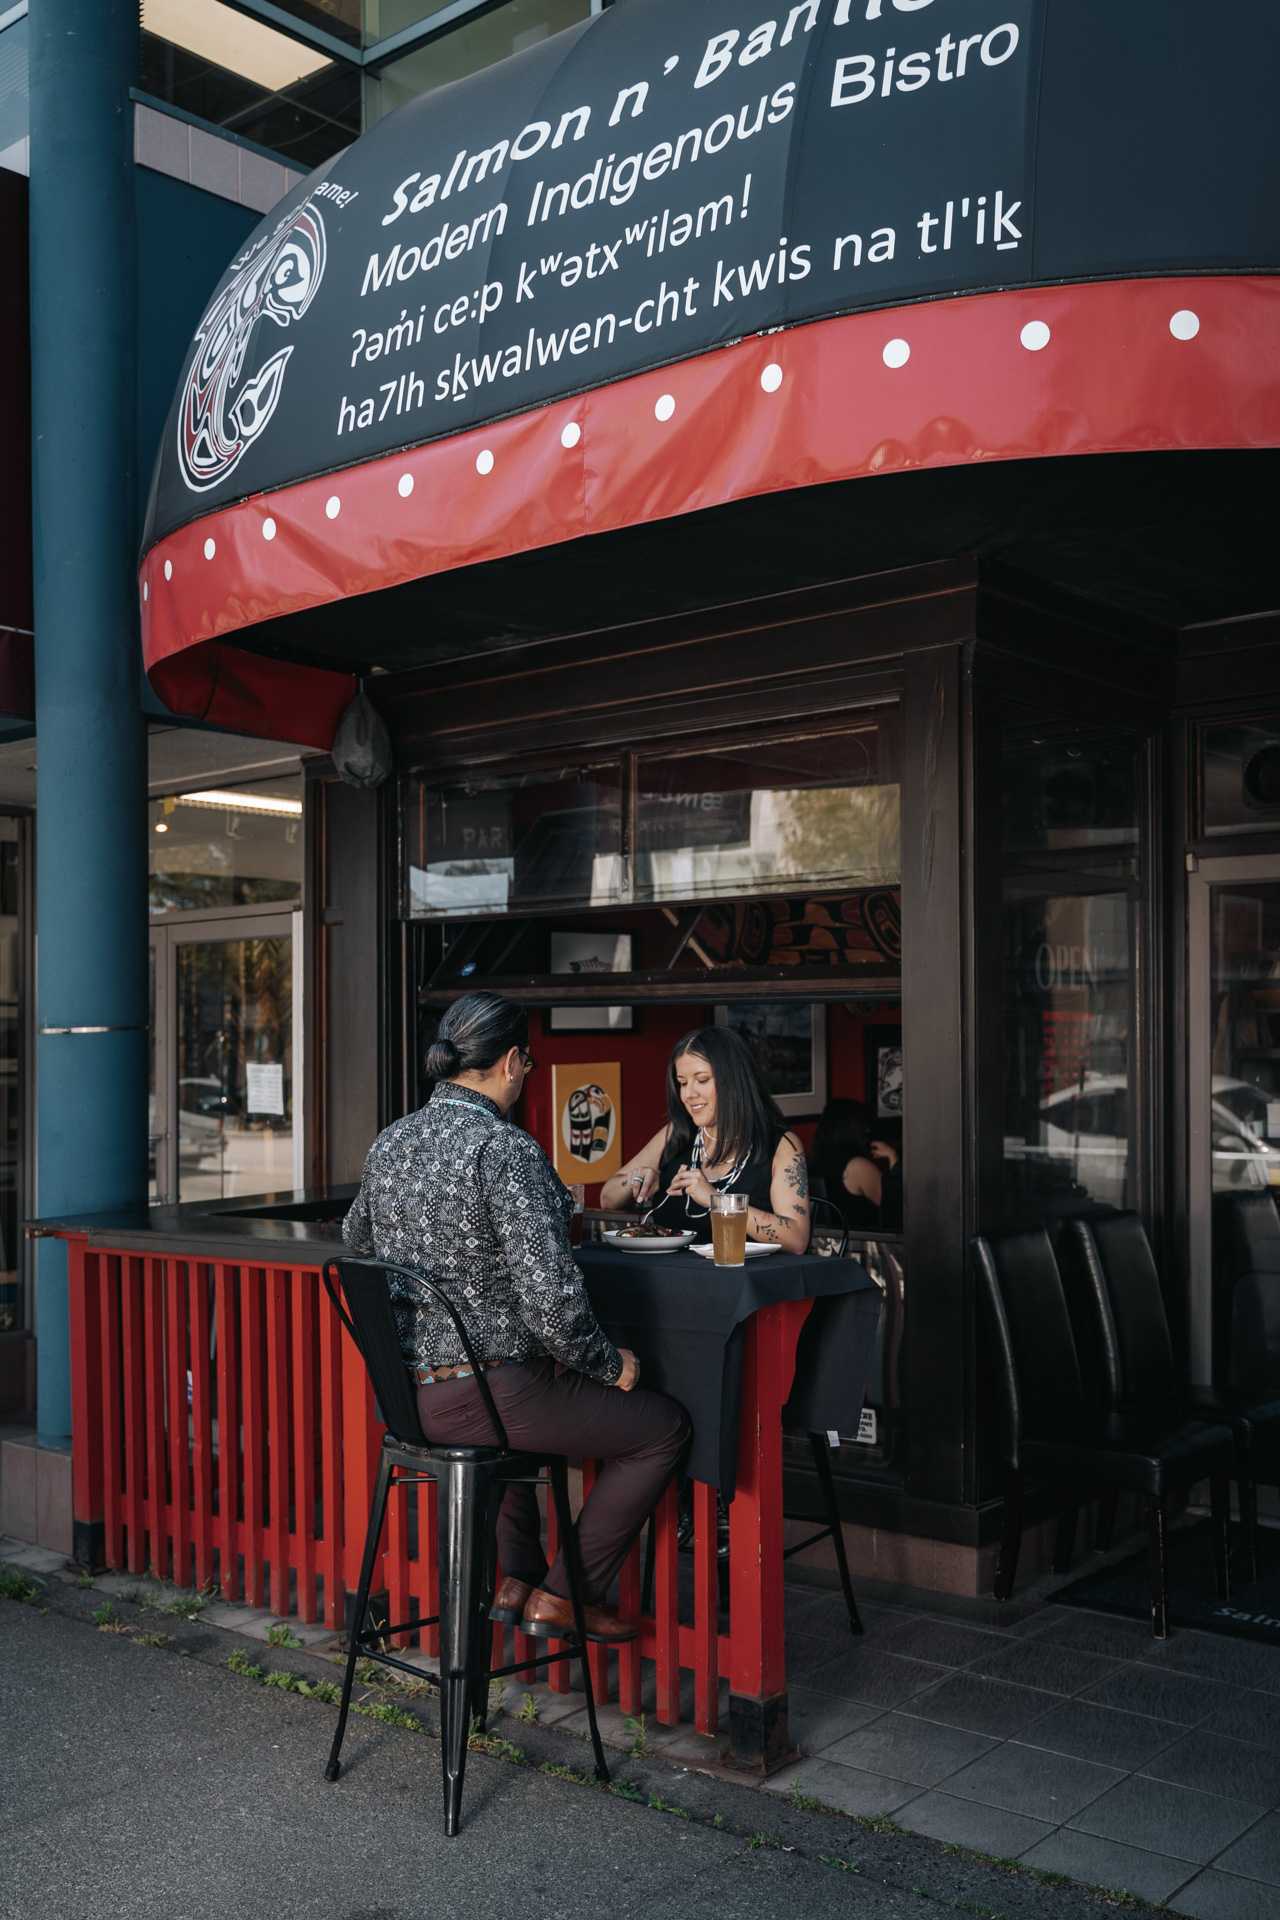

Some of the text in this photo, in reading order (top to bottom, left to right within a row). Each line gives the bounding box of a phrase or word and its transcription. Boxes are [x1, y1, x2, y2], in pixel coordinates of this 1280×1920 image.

[313, 181, 360, 209] ame!
[360, 202, 509, 300] Modern
[527, 81, 796, 227] Indigenous
[830, 22, 1020, 108] Bistro
[381, 105, 592, 227] Salmon
[337, 370, 425, 436] ha7lh
[712, 236, 812, 308] kwis
[833, 227, 896, 271] na
[1035, 943, 1098, 992] OPEN
